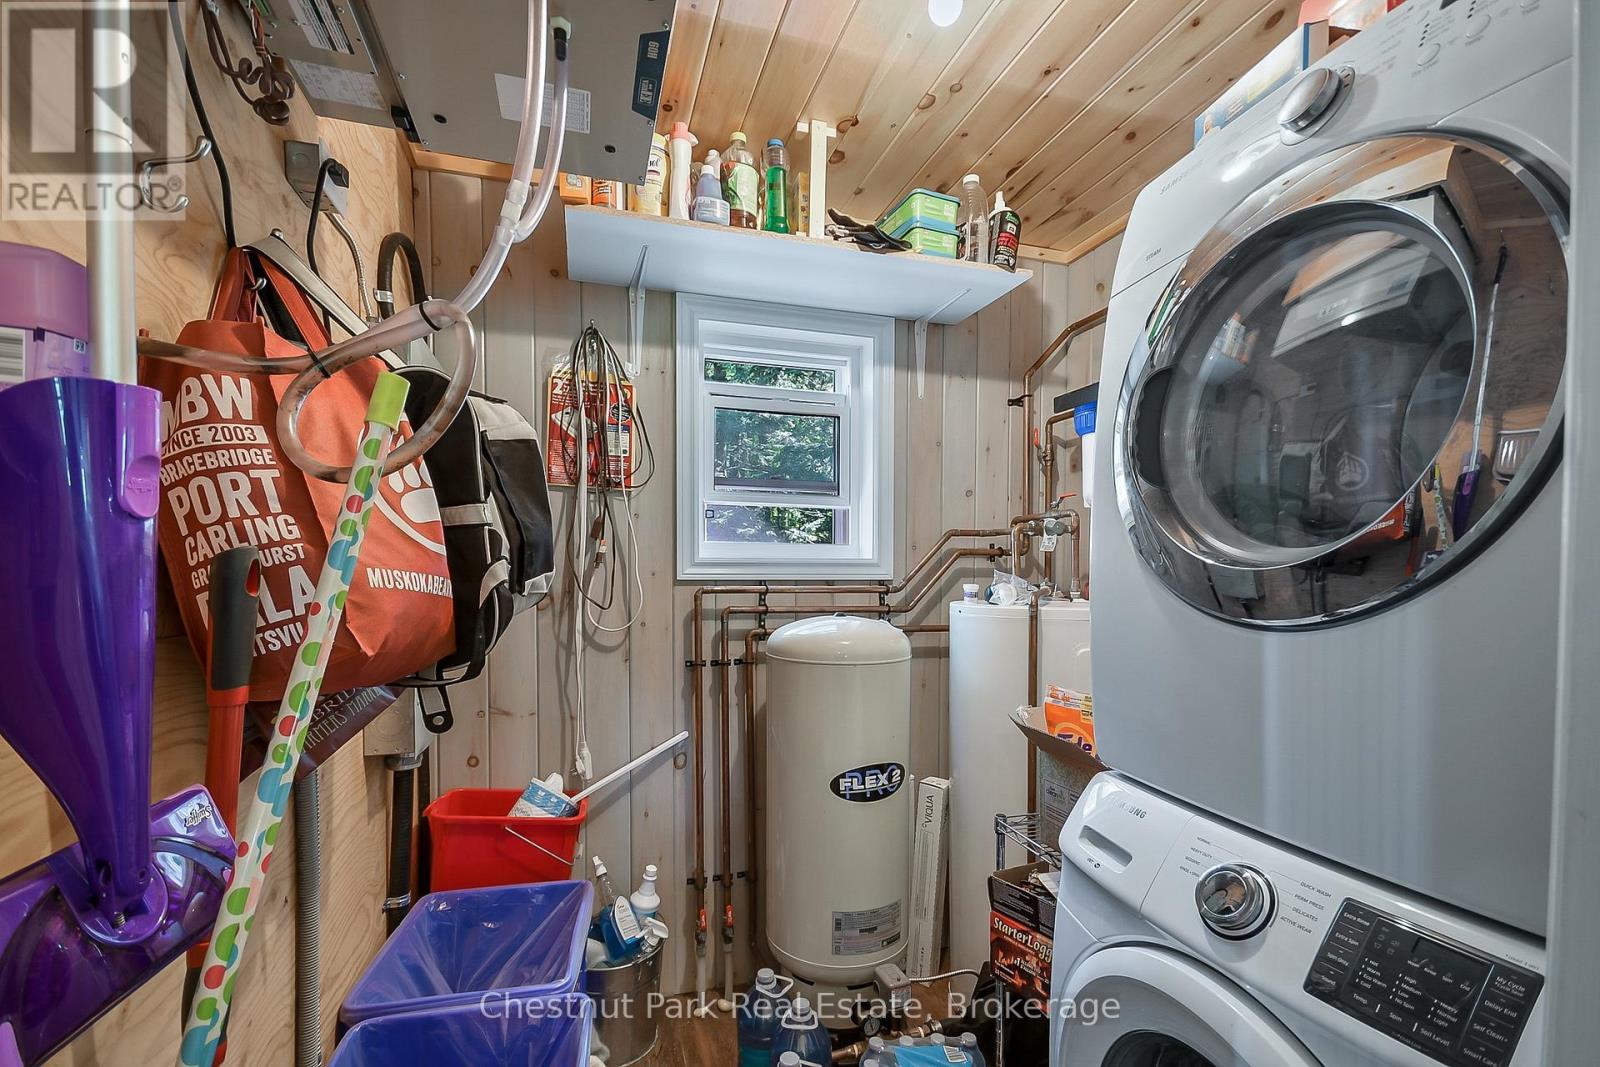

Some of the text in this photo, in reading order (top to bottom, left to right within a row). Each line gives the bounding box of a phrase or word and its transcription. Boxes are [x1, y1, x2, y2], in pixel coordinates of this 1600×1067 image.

[208, 425, 257, 442] 2003
[160, 448, 277, 487] BRACEBRIDGE
[168, 469, 282, 536] PORT
[184, 514, 301, 567] CARLING
[924, 795, 935, 824] VIQUA
[1300, 881, 1332, 899] QUICK WASH
[1294, 893, 1325, 911] PERM PRESS
[1291, 906, 1319, 922] DELICATES
[1343, 911, 1357, 921] Extra
[1280, 915, 1313, 935] ACTIVE WEAR
[993, 916, 1053, 963] StarterLogg
[1335, 932, 1348, 941] Extra
[1362, 973, 1372, 981] Eco
[1404, 975, 1417, 985] High
[1496, 975, 1526, 992] My Cycle
[1397, 990, 1409, 999] Low
[1400, 983, 1422, 995] Medium
[1436, 1009, 1458, 1023] Normal
[1439, 1001, 1459, 1015] Heavy
[1484, 1000, 1518, 1018] Delay End
[1433, 1017, 1449, 1029] Light
[1473, 1022, 1487, 1033] Self
[1420, 1027, 1433, 1039] Soil
[1432, 1034, 1450, 1047] Level
[1463, 1047, 1483, 1061] Smart
